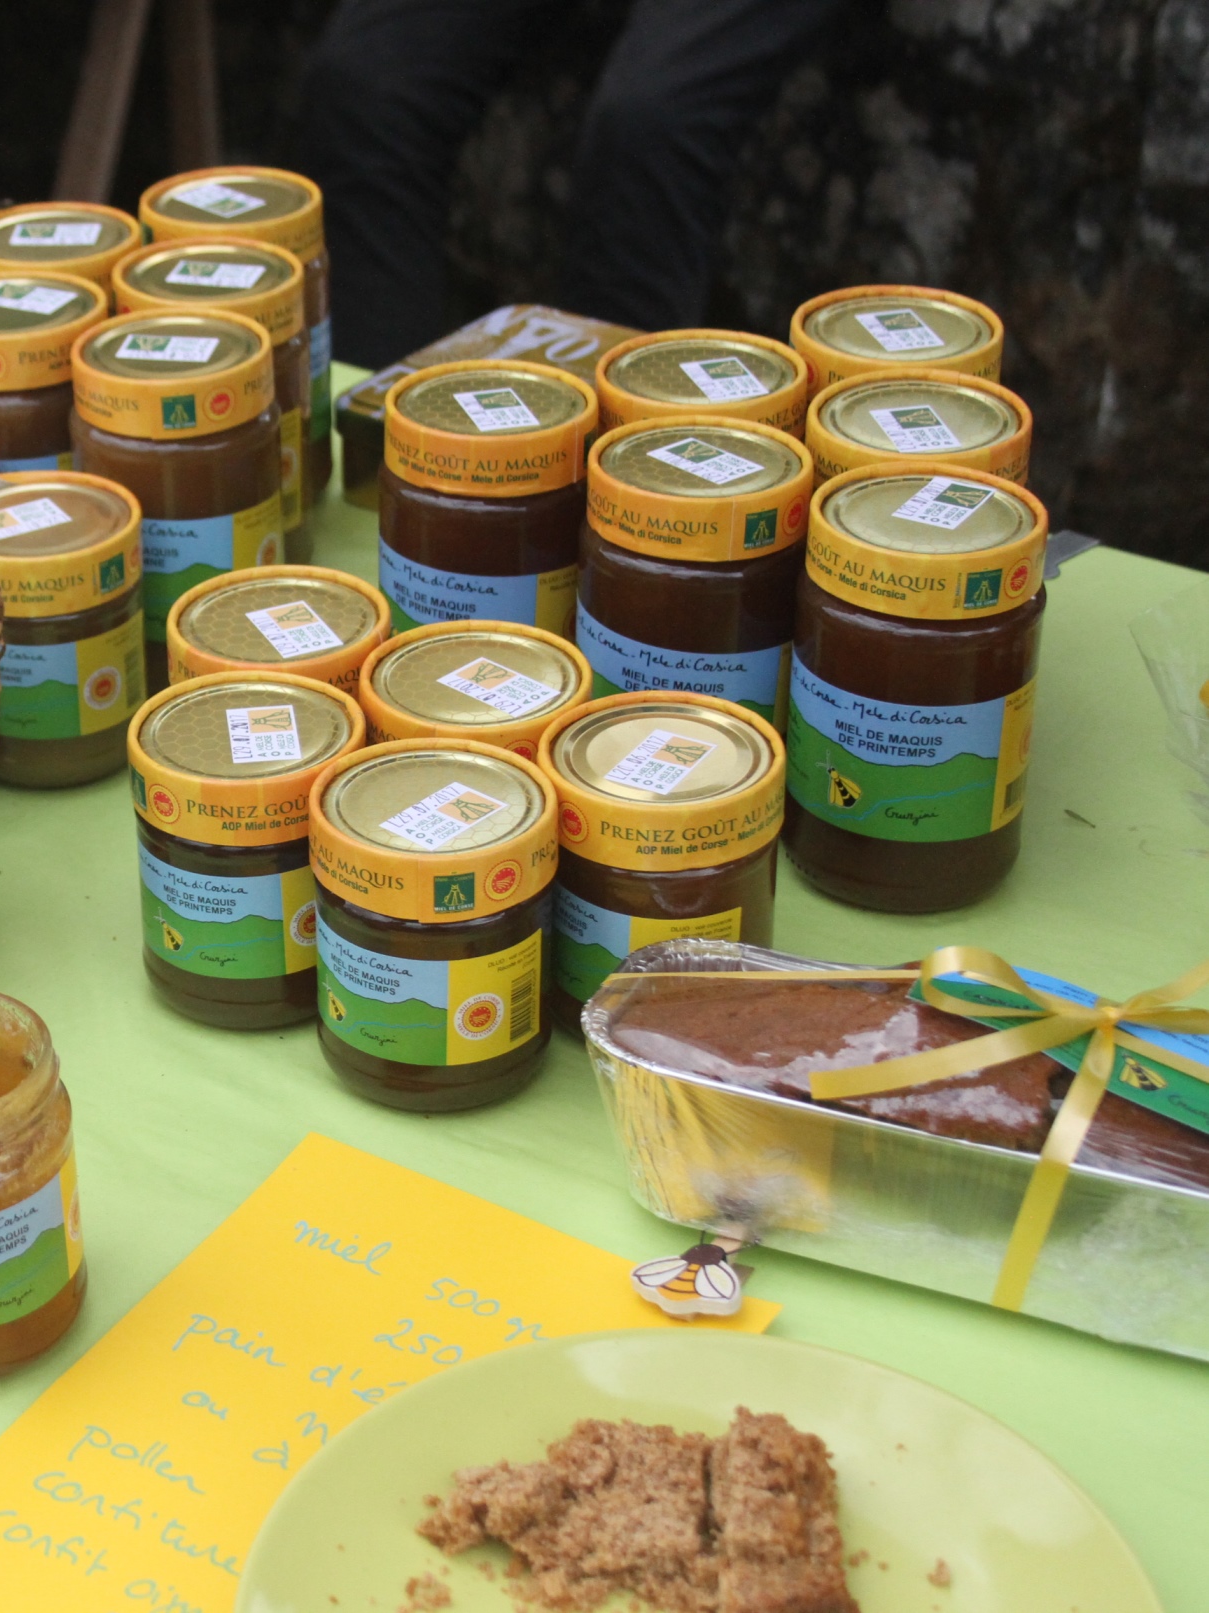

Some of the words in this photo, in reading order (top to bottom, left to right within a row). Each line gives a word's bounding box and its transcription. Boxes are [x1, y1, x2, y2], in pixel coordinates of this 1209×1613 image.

[424, 451, 470, 471] GOÛT
[475, 456, 499, 472] AU
[505, 451, 568, 472] MAQUIS
[621, 509, 641, 525] AU
[647, 515, 718, 536] MAQUIS
[648, 531, 683, 546] Corsica
[18, 573, 85, 591] MAQUIS
[844, 560, 866, 577] AU
[870, 571, 947, 593] MAQUIS
[414, 592, 427, 604] DE
[431, 597, 477, 613] MAQUIS
[871, 583, 907, 601] Corsica
[622, 667, 648, 685] MIEL
[652, 677, 669, 688] DE
[673, 681, 725, 694] MAQUIS
[835, 719, 863, 738] MIEL
[867, 730, 885, 743] DE
[888, 734, 943, 747] MAQUIS
[838, 732, 856, 746] DE
[858, 739, 937, 758] PRINTEMPS
[186, 798, 259, 819] PRENEZ
[264, 794, 310, 817] GOÛ
[385, 785, 461, 828] L29.07.2017
[221, 822, 242, 831] AOP
[245, 821, 266, 831] Miel
[269, 819, 281, 829] de
[600, 820, 676, 843] PRENEZ
[682, 817, 738, 841] GOÛT
[741, 809, 762, 828] AU
[635, 845, 657, 855] AOP
[661, 845, 683, 855] Miel
[687, 843, 699, 854] de
[701, 837, 728, 851] Corse
[337, 857, 405, 891] MAQUIS
[339, 873, 369, 895] Corsica
[163, 884, 182, 898] MIEL
[183, 892, 195, 902] DE
[197, 895, 237, 907] MAQUIS
[166, 893, 178, 905] DE
[179, 900, 233, 916] PRINTEMPS
[330, 952, 347, 972] MIEL
[348, 964, 361, 977] DE
[361, 970, 401, 988] MAQUIS
[333, 964, 343, 977] DE
[344, 970, 396, 996] PRINTEMPS
[294, 1219, 393, 1276] miel
[424, 1277, 501, 1317] 500
[171, 1313, 287, 1368] pain
[373, 1319, 464, 1365] 250
[181, 1391, 229, 1422] ou
[66, 1424, 207, 1497] pollen
